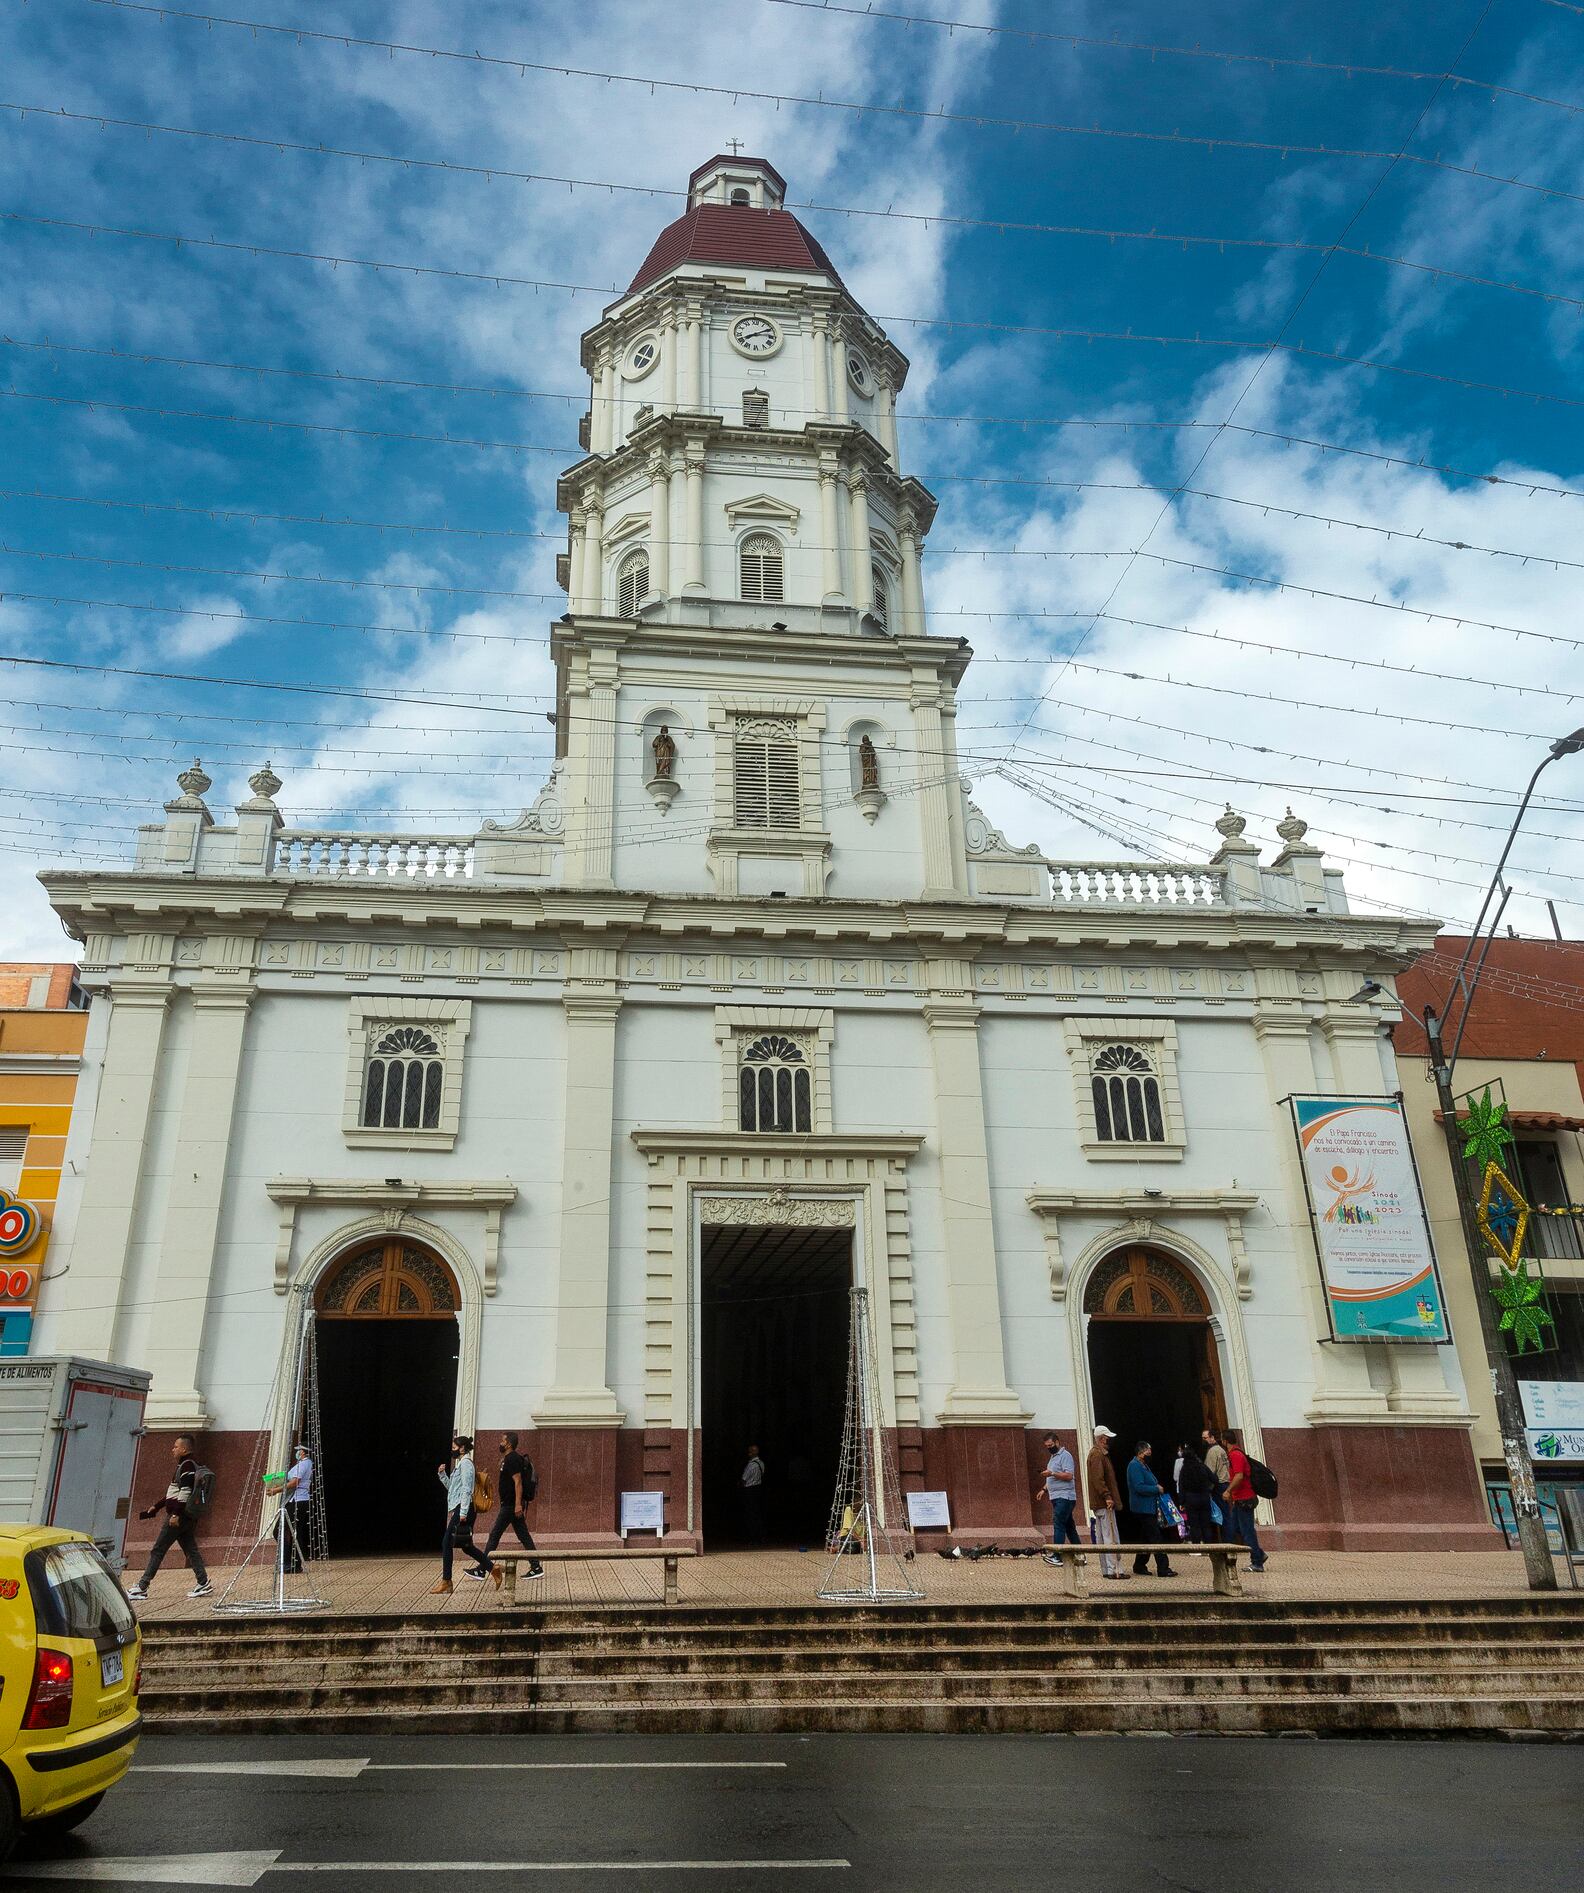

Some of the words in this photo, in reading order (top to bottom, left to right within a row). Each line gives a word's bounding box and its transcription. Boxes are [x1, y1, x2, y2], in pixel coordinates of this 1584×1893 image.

[1337, 1130, 1349, 1138] Papa
[7, 1367, 16, 1378] DE
[16, 1367, 52, 1378] ALIMENTOS
